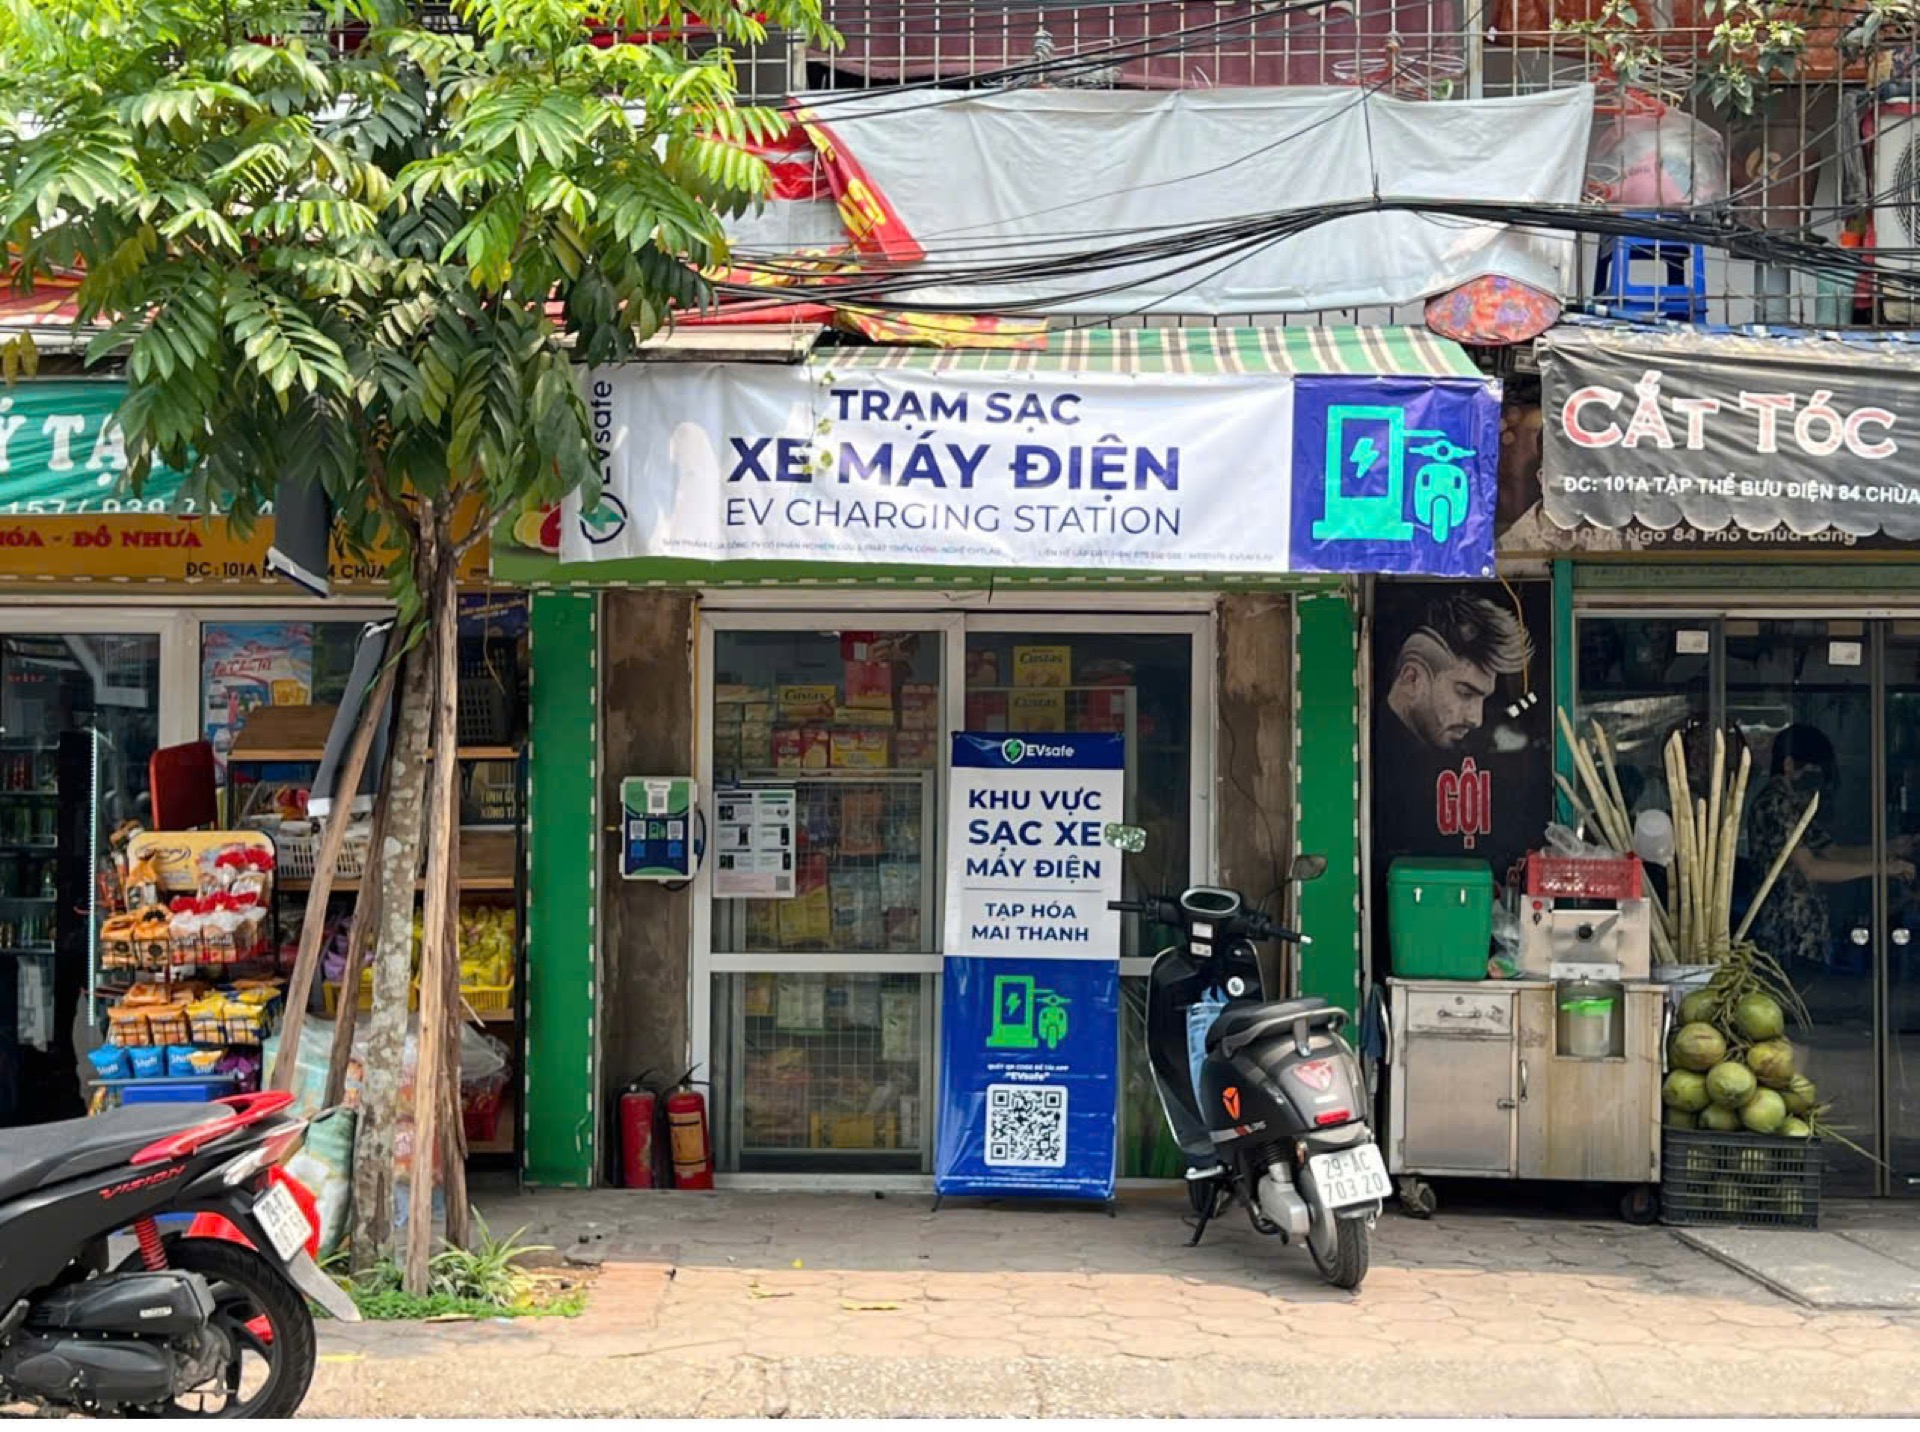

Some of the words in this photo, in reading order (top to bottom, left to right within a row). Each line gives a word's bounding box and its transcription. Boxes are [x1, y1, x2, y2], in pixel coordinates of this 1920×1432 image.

[831, 389, 968, 431] TRẠM
[985, 392, 1081, 433] SẠC
[1562, 369, 1719, 450] CẮT
[1740, 390, 1898, 459] TÓC
[727, 437, 813, 482] XE
[839, 430, 990, 488] MÁY
[1009, 433, 1179, 502] ĐIỆN
[1564, 477, 1597, 492] ĐC:
[1603, 476, 1649, 491] 101A
[1654, 474, 1691, 496] TẬP
[1741, 478, 1781, 496] BƯU
[1787, 480, 1832, 502] ĐIỆN
[1839, 485, 1860, 500] 84
[1866, 482, 1920, 504] CHÙA
[727, 498, 774, 526] EV
[787, 500, 1000, 532] CHARGING
[1013, 504, 1180, 536] STATION
[0, 526, 44, 547] ÓA
[1026, 744, 1074, 757] EVsafe
[969, 789, 1030, 809] KHU
[1040, 787, 1102, 815] VỰC
[1437, 756, 1491, 849] GỘI
[969, 820, 1042, 851] SẠC
[1054, 822, 1102, 845] XE
[966, 851, 1026, 876] MÁY
[1034, 855, 1101, 883] ĐIỆN
[985, 903, 1024, 921] TẠP
[1032, 901, 1076, 918] HÓA
[971, 925, 1009, 939] MAI
[1016, 926, 1089, 941] THANH
